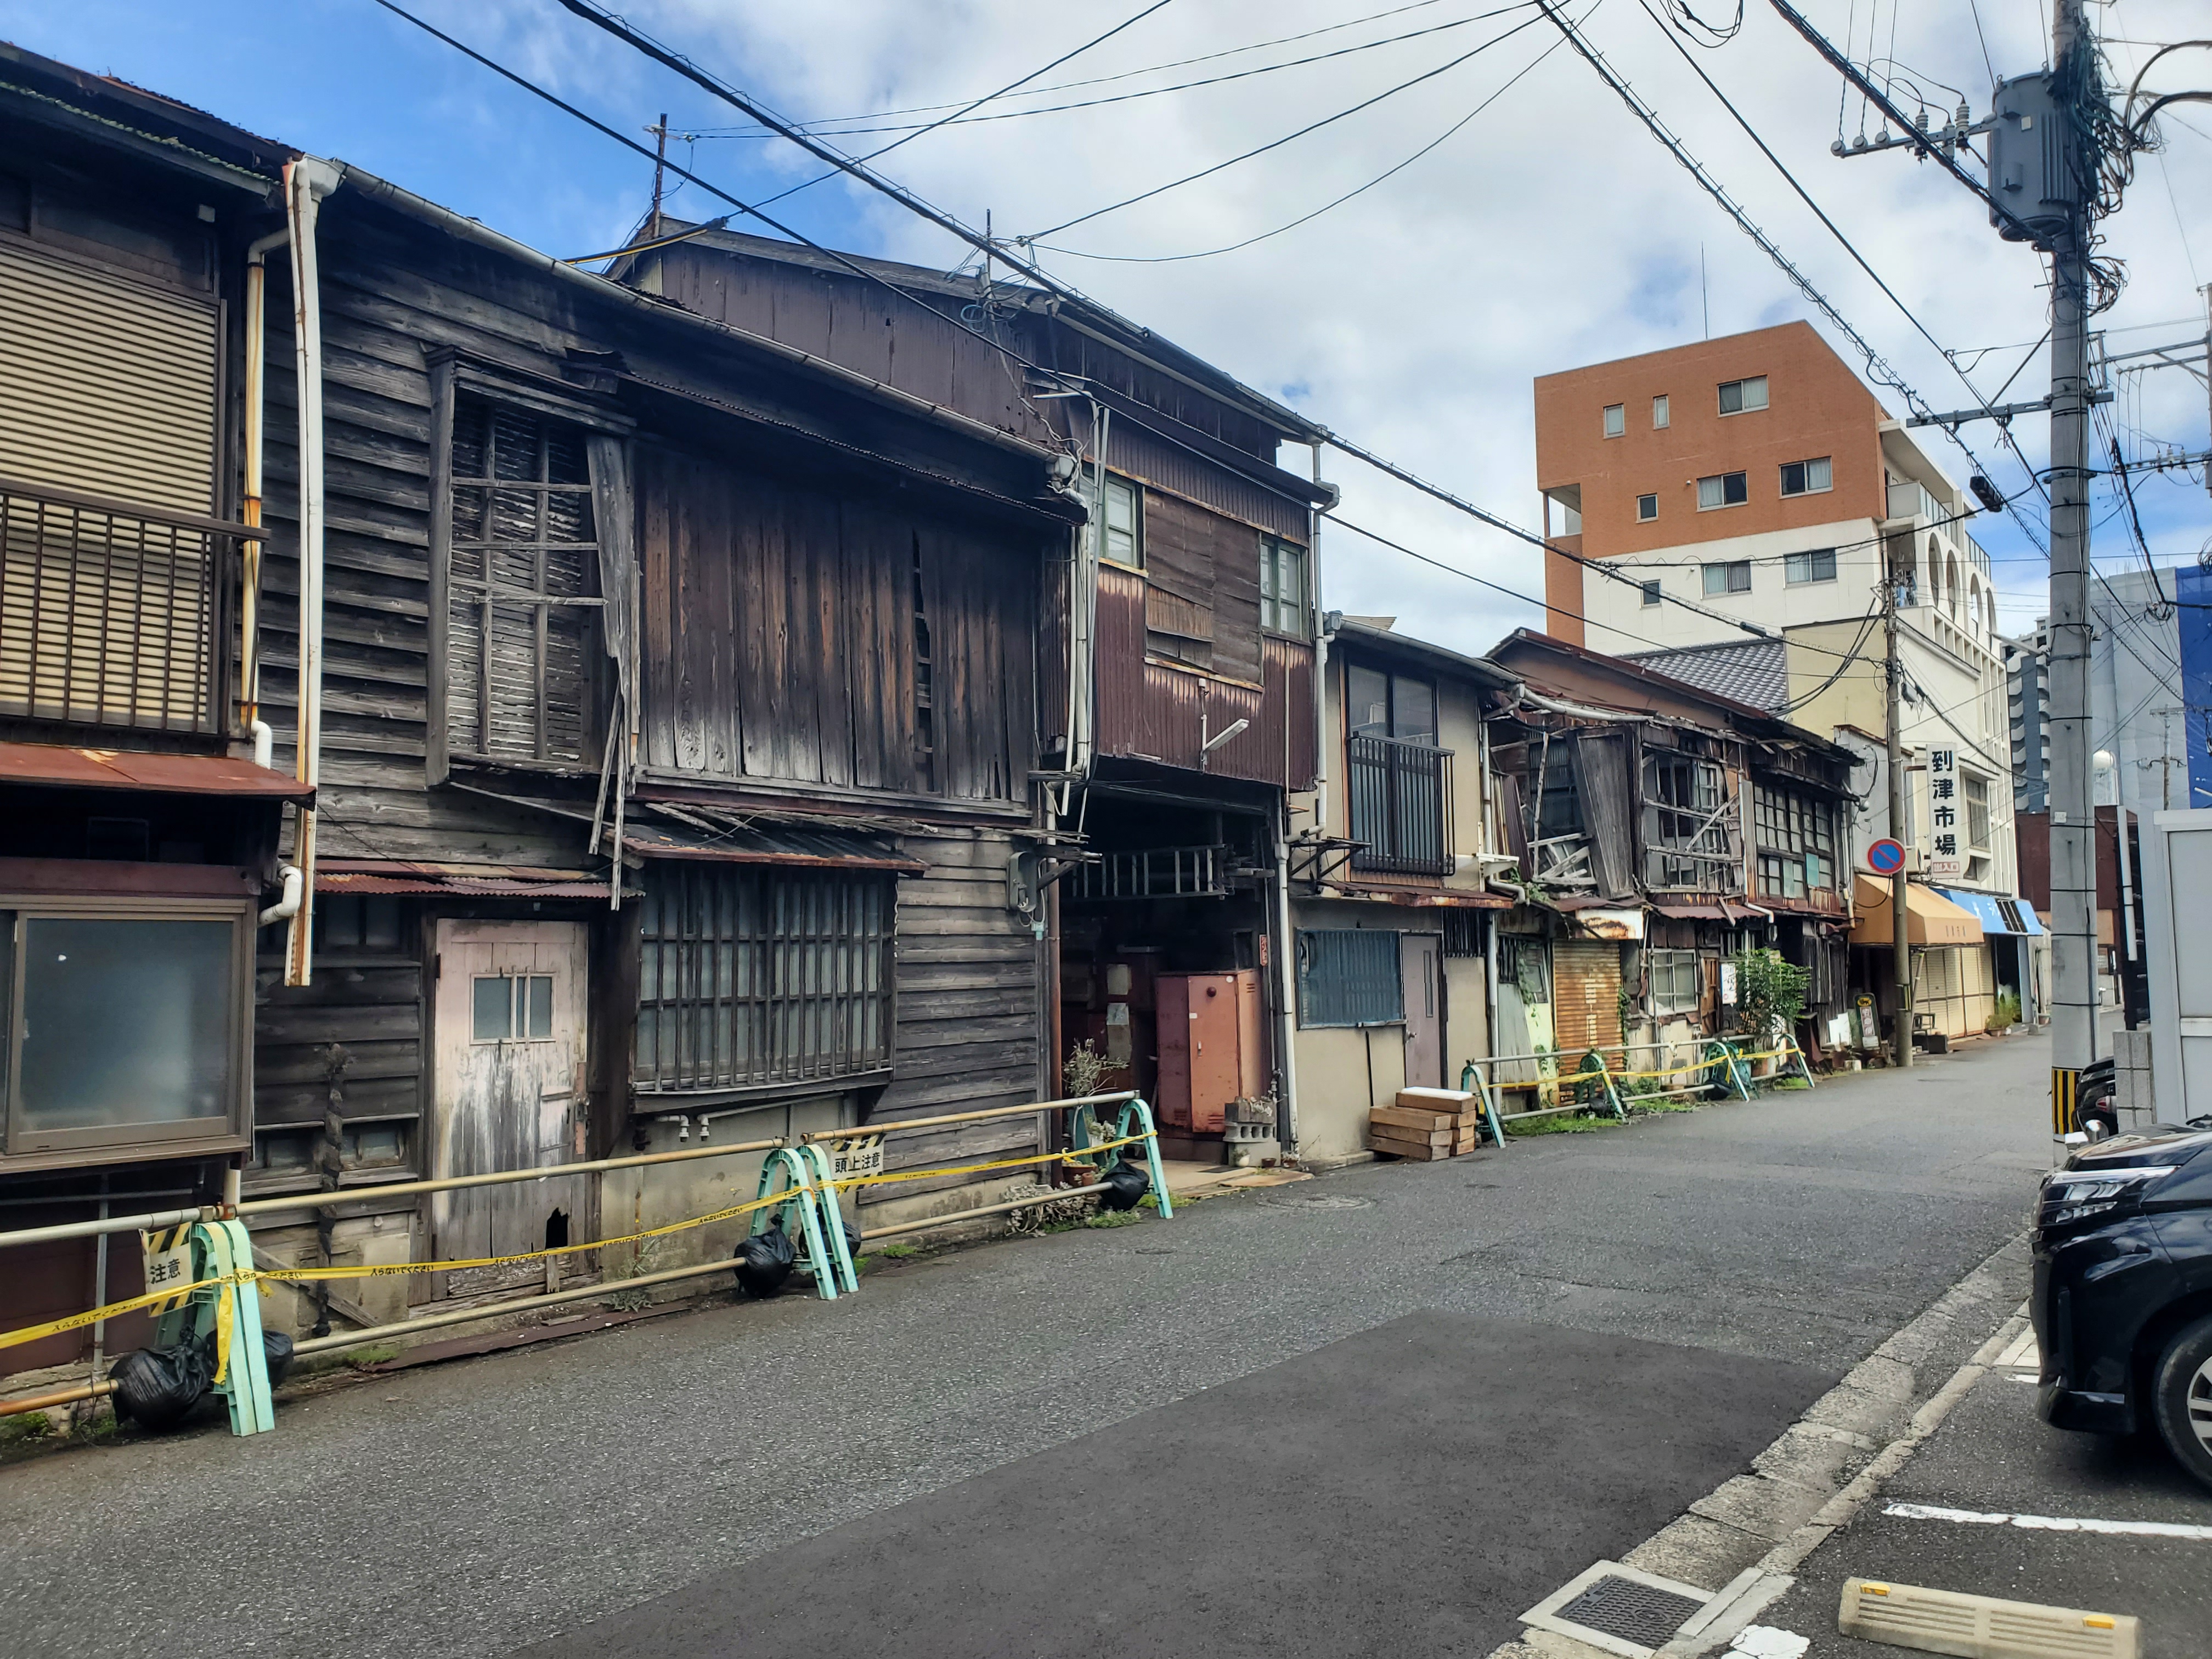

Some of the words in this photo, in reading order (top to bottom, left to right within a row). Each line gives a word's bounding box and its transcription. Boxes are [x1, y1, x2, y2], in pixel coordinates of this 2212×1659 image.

[1931, 749, 1956, 856] 到津市場
[1933, 862, 1959, 873] 出入口
[834, 1151, 881, 1173] 頭上注意
[149, 1258, 180, 1285] 注意
[370, 1265, 434, 1277] 入らないでください
